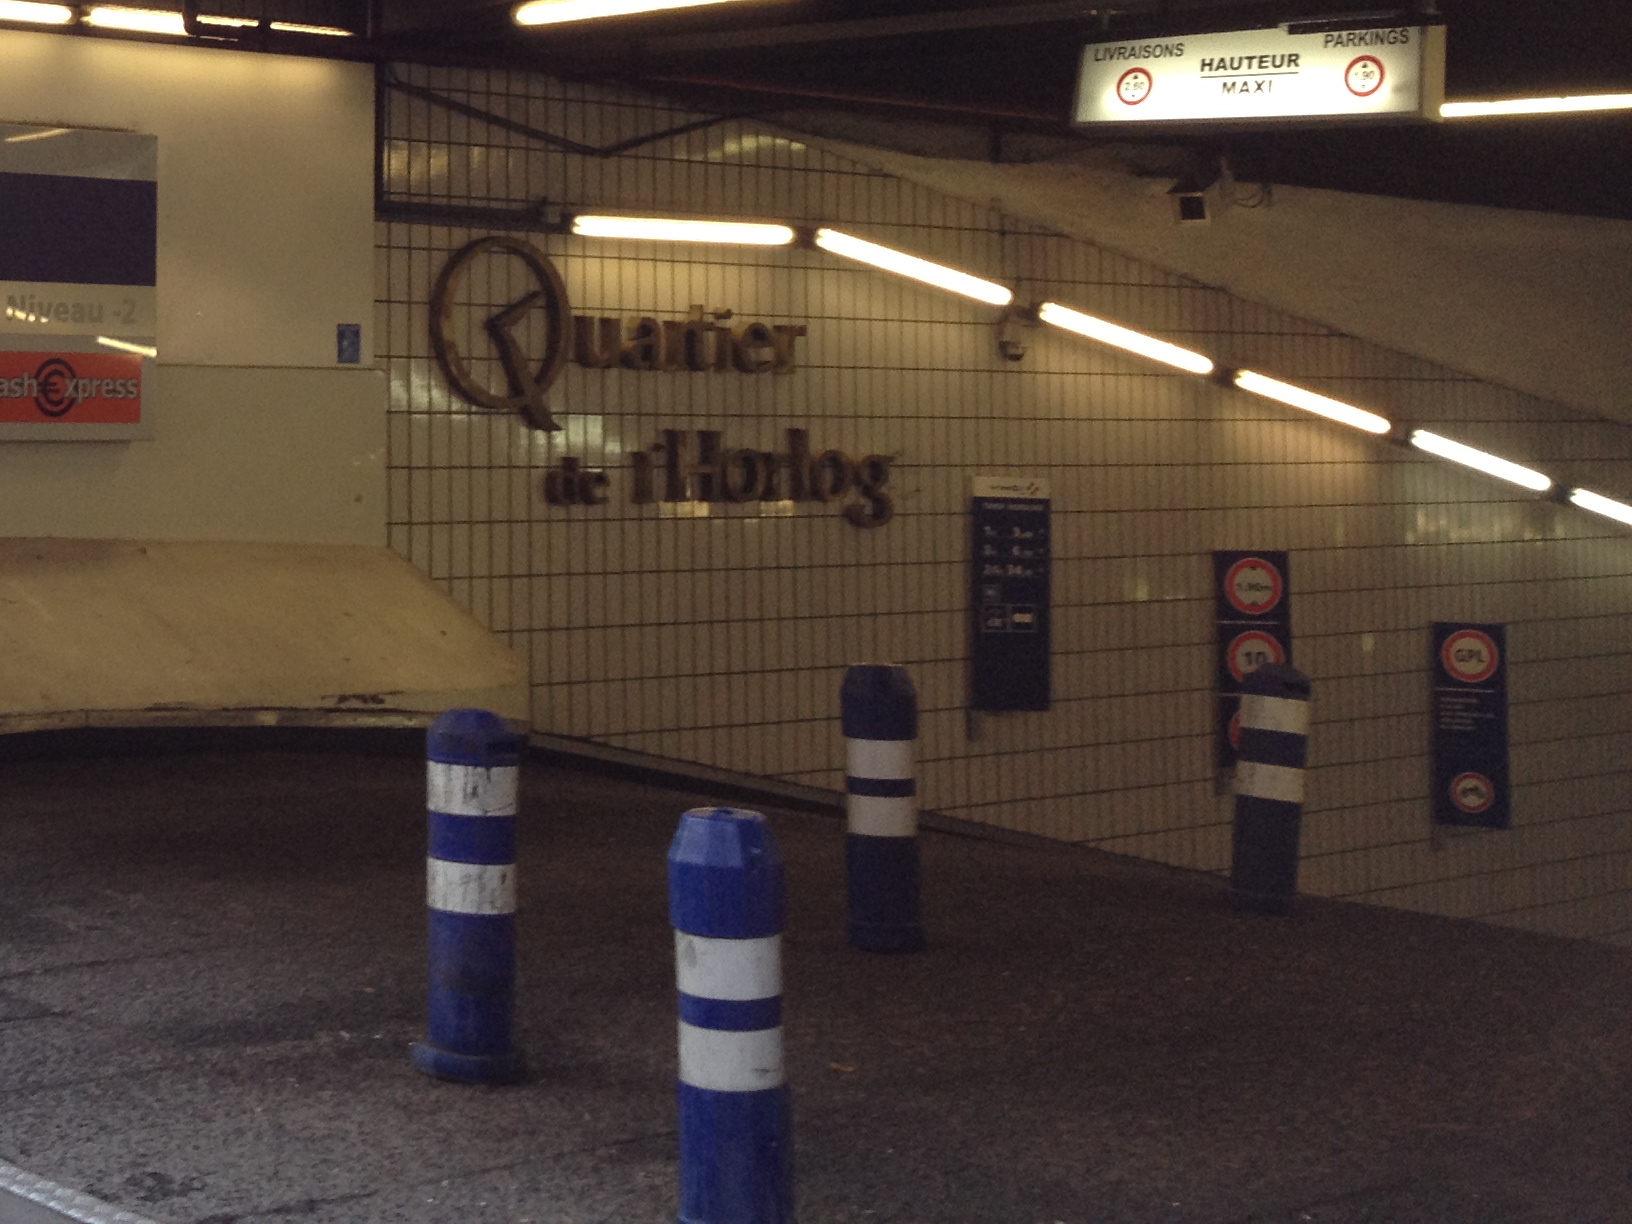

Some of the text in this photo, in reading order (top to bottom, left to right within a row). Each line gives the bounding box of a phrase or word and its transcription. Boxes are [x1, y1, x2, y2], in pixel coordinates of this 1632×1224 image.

[1323, 29, 1410, 49] PARKINGS
[1093, 42, 1186, 62] LIVRAISONS
[1200, 53, 1300, 72] HAUTEUR
[1222, 78, 1273, 95] MAXI
